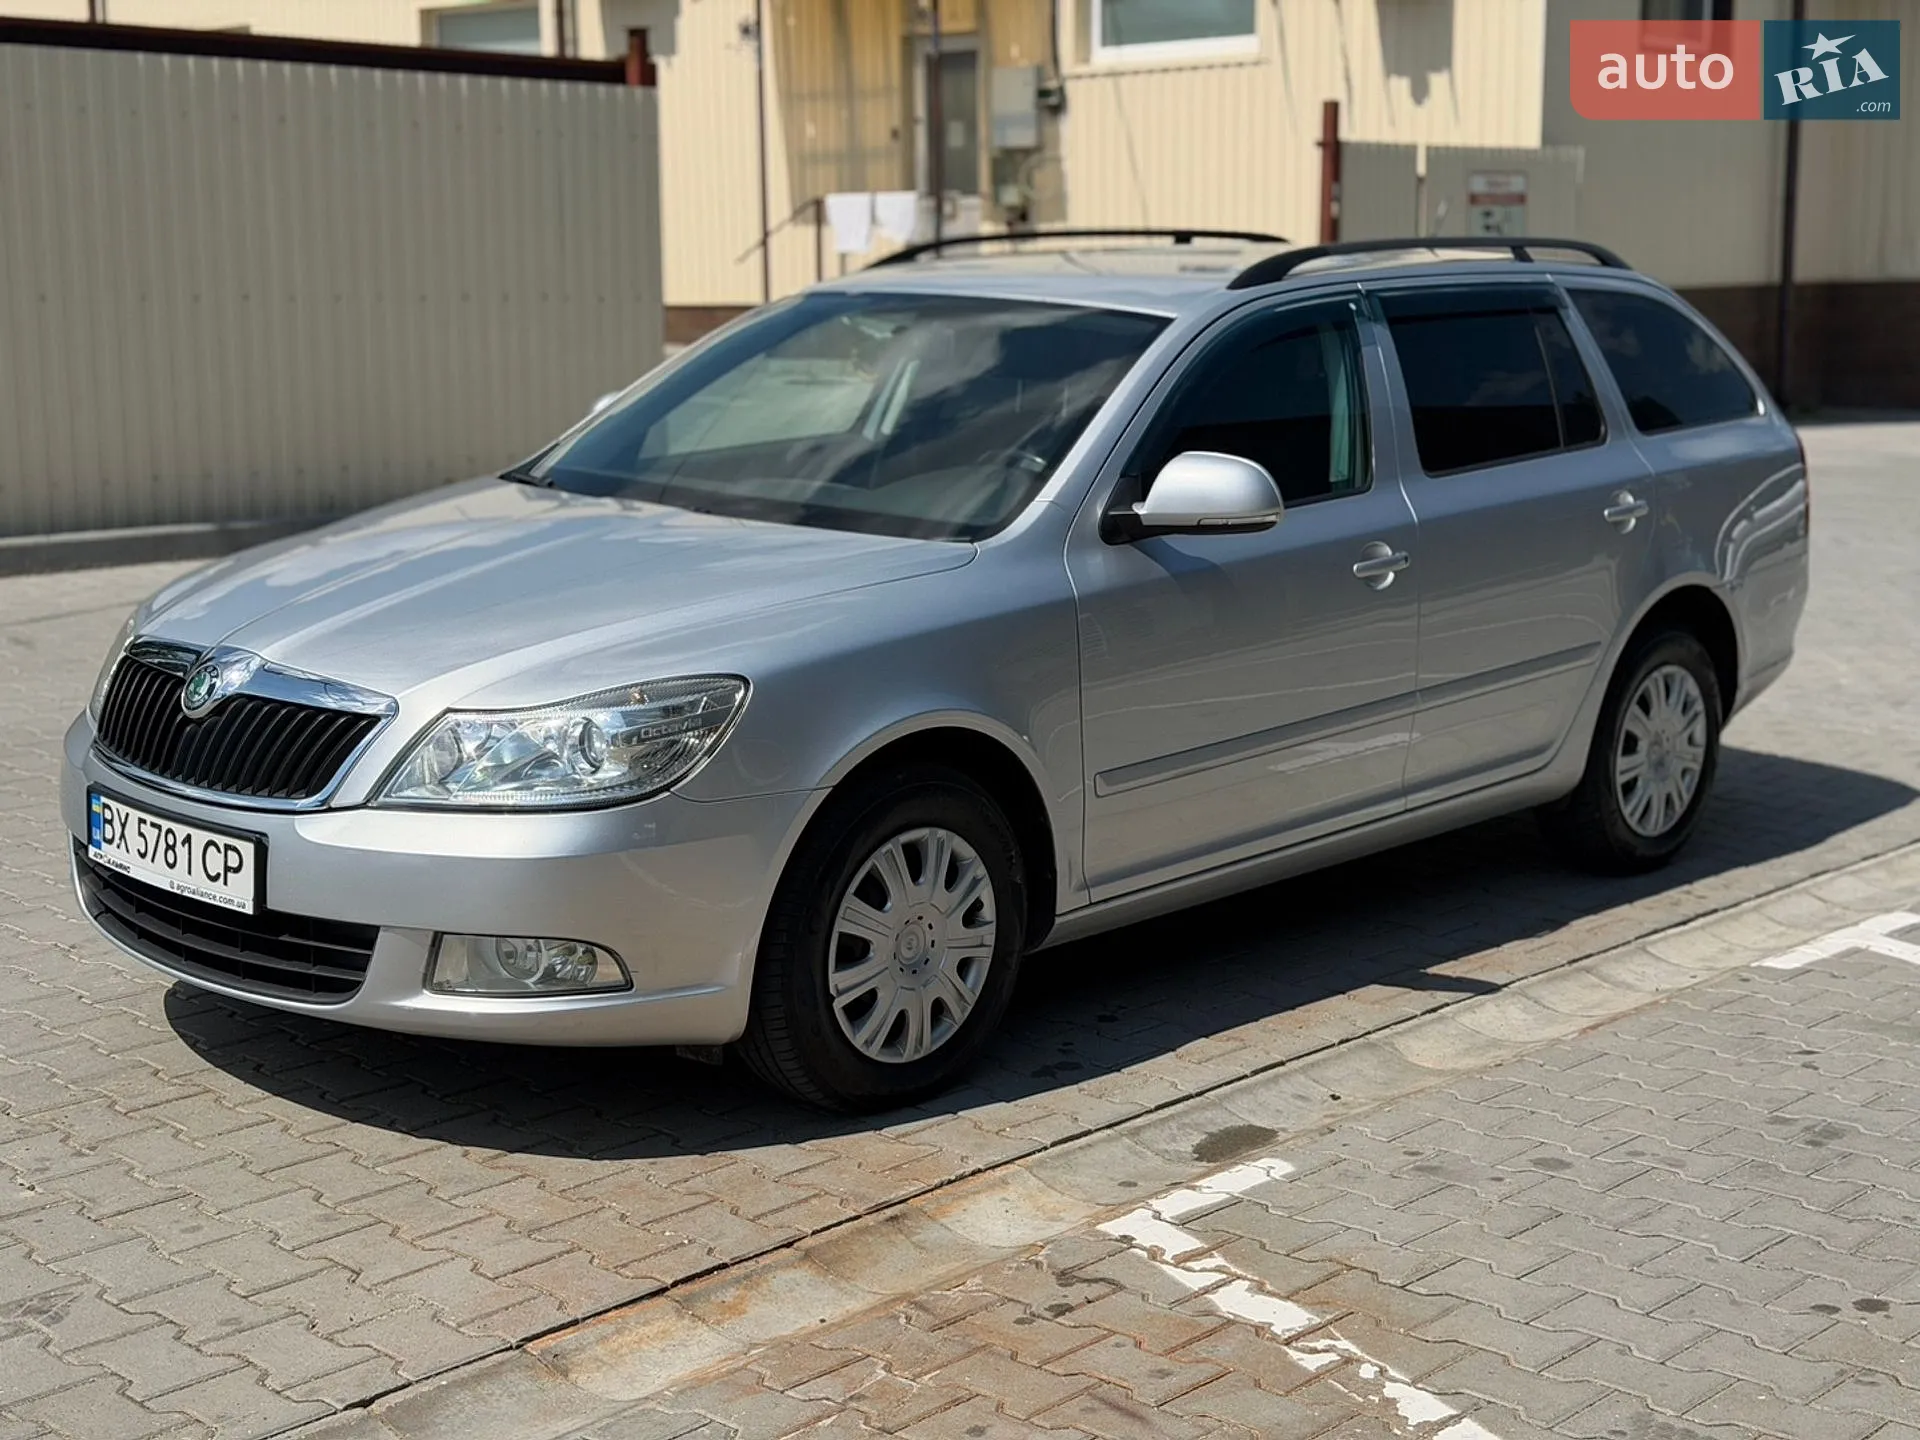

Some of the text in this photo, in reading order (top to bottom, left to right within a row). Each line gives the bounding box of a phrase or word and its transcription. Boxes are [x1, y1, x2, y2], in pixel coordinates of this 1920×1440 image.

[102, 802, 130, 855] BX
[136, 816, 192, 876] 5781
[201, 839, 244, 886] CP
